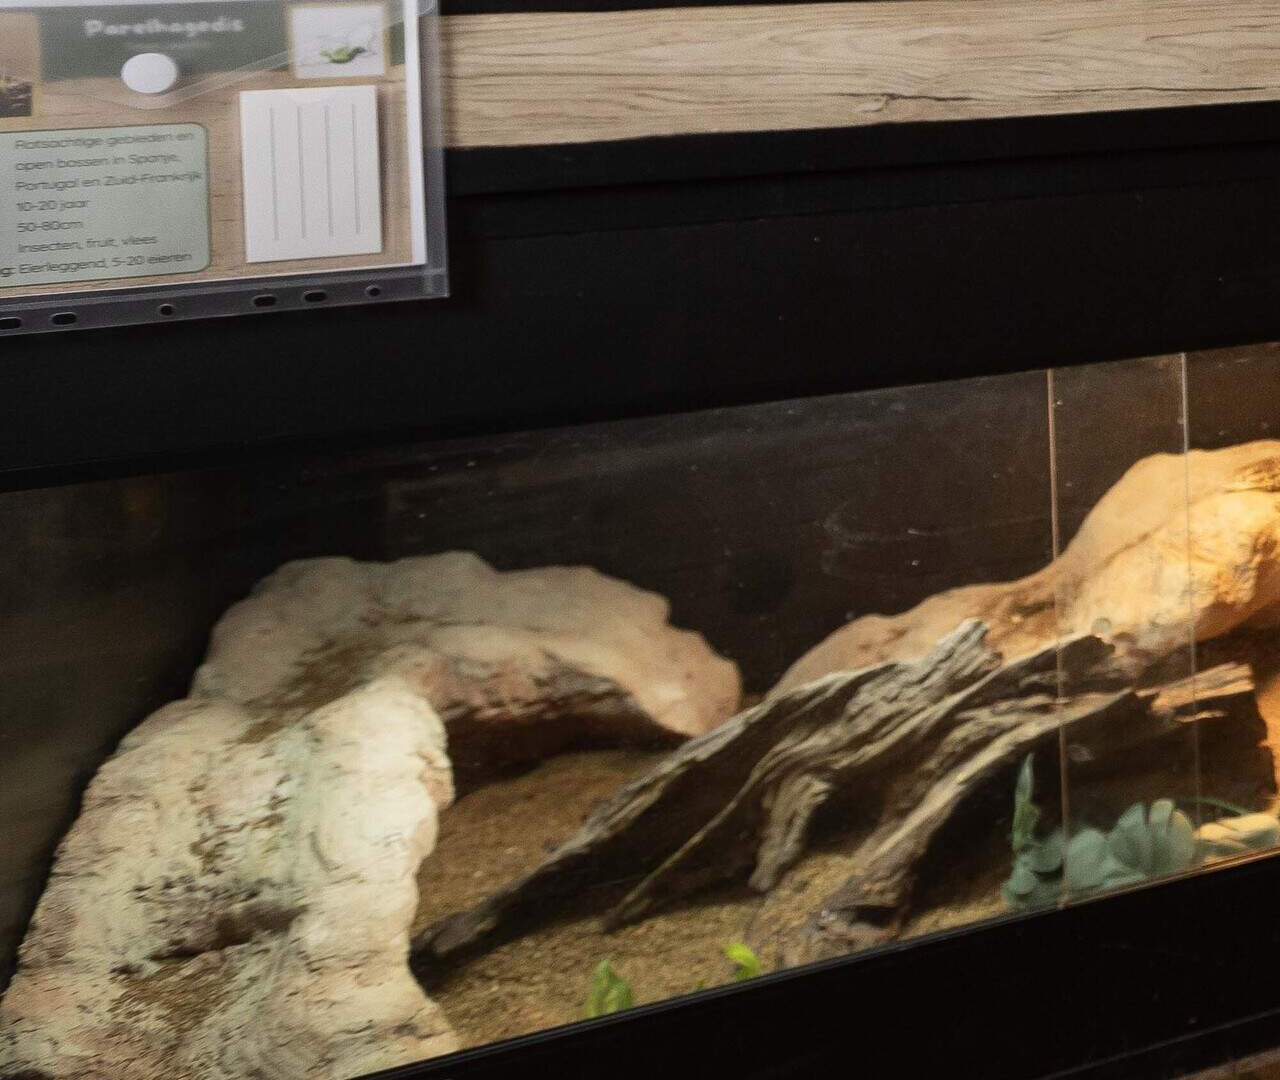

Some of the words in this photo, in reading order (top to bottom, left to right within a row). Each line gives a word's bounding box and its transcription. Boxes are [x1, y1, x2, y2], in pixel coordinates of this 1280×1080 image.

[105, 133, 172, 147] gebieden
[175, 132, 194, 141] en
[15, 160, 53, 171] open
[56, 158, 108, 168] bossen
[113, 155, 125, 164] in
[15, 178, 77, 191] Portugal
[81, 179, 100, 187] en
[16, 200, 57, 211] 10-20
[59, 200, 89, 211] jaar
[121, 235, 158, 246] vlees
[111, 255, 145, 267] 5-20
[147, 253, 192, 263] eieren
